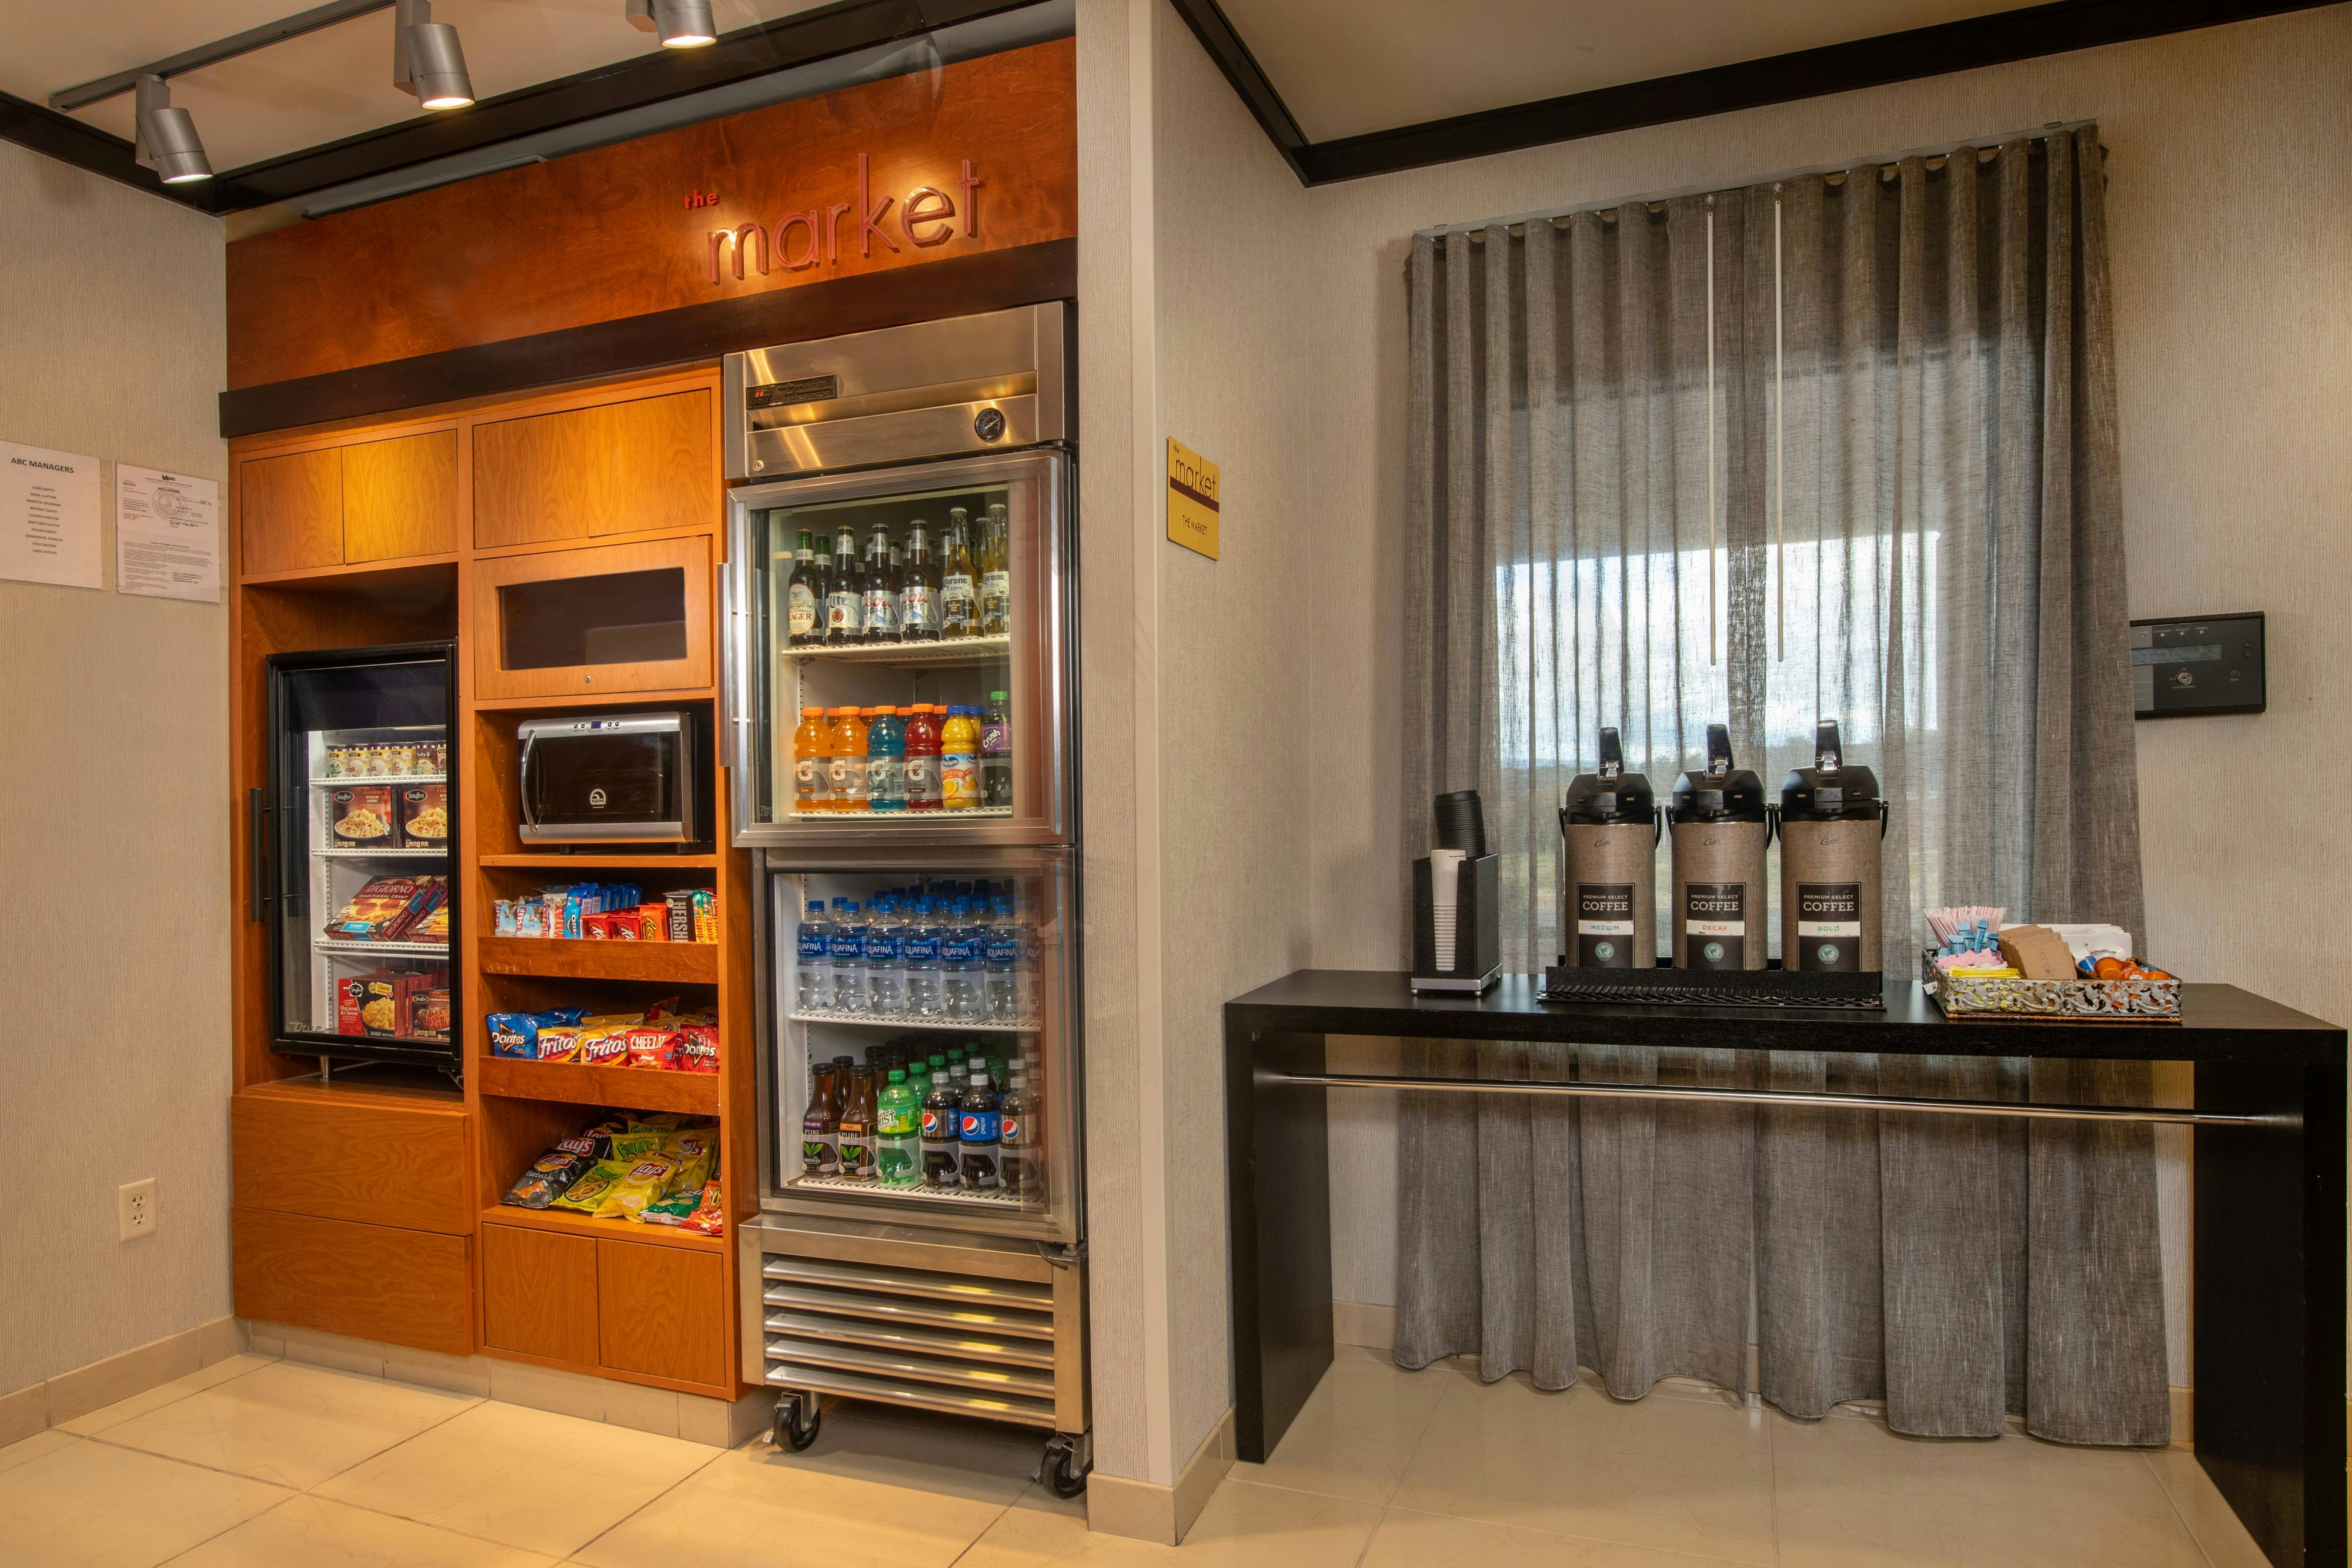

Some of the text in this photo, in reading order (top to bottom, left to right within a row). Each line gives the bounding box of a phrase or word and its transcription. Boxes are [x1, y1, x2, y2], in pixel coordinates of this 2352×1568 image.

[684, 190, 719, 209] the
[707, 153, 981, 284] market
[11, 457, 74, 473] ABC MANAGERS
[1175, 456, 1216, 500] market
[1182, 514, 1207, 536] THE MARKET
[944, 578, 968, 587] Corona
[983, 728, 1001, 748] Crush
[366, 884, 414, 894] DIGIORNO
[1583, 901, 1628, 911] COFFEE
[1690, 901, 1739, 911] COFFEE
[1803, 901, 1854, 911] COFFEE
[517, 907, 526, 925] CLIF
[672, 902, 689, 941] HERSH
[386, 911, 408, 935] DIGIORNO
[798, 942, 823, 952] QUAFINA
[987, 947, 1018, 958] AQUAFINA
[1027, 948, 1040, 958] AQUA
[492, 1032, 526, 1044] Doritos
[537, 1034, 579, 1059] Fritos
[584, 1037, 628, 1062] Fritos
[684, 1043, 716, 1057] Doritos
[540, 1155, 572, 1165] Lay's
[631, 1163, 667, 1175] Lay's
[525, 1170, 554, 1182] Barbecue
